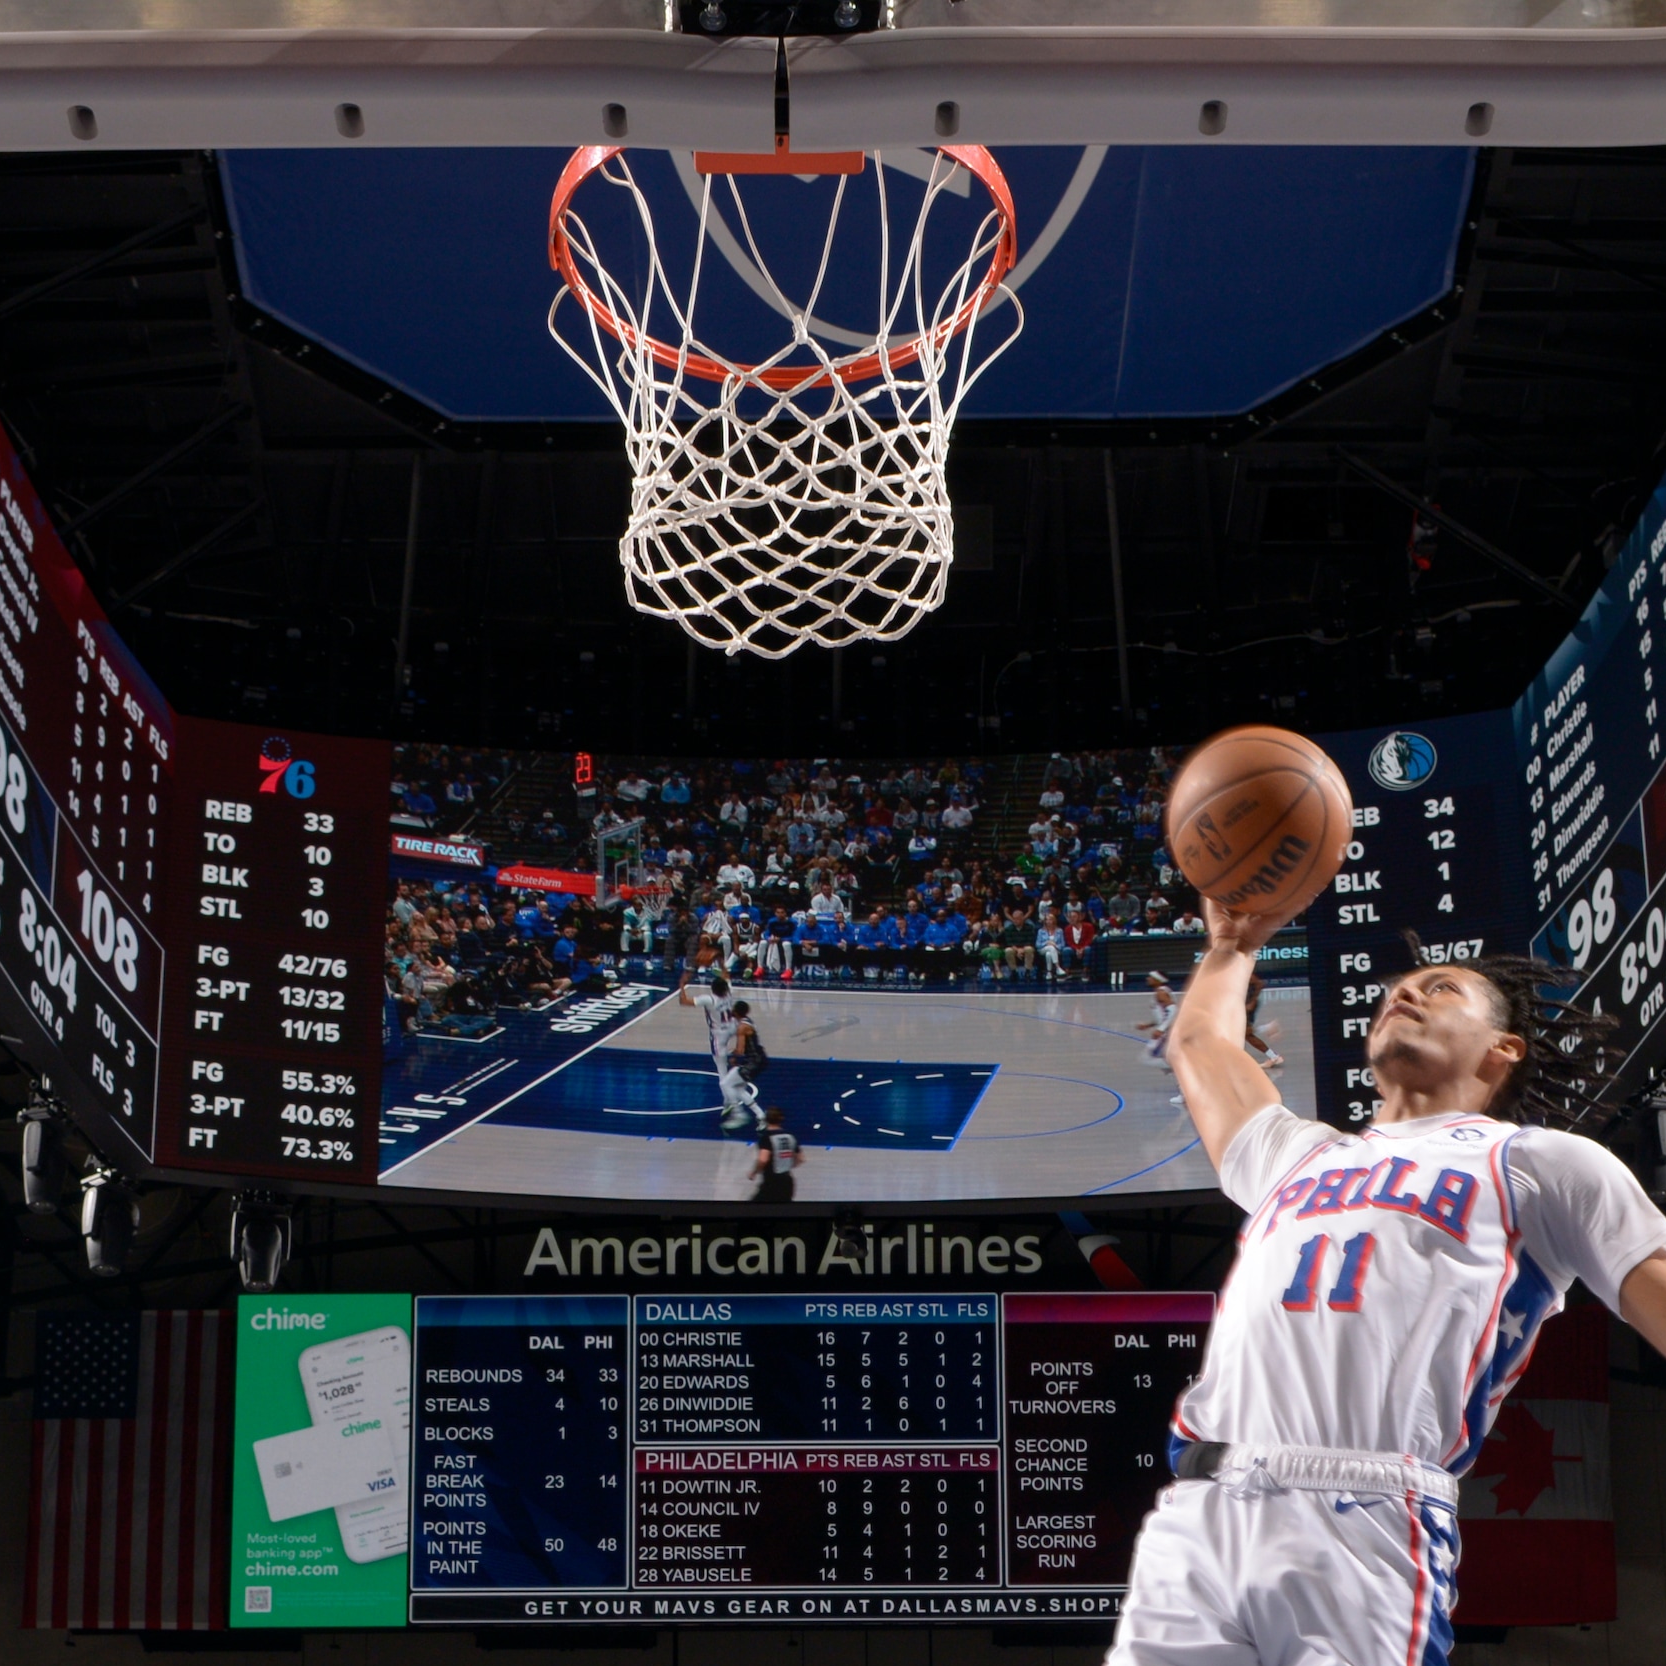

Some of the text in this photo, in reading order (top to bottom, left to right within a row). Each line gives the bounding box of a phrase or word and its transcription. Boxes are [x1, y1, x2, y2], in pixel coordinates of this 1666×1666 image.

[259, 759, 315, 799] 76
[206, 800, 333, 833] REB 33
[204, 832, 331, 865] TO 10
[203, 864, 323, 896] BLK 3
[200, 896, 329, 928] STL 10
[1568, 868, 1616, 970] 98
[77, 869, 138, 992] 108
[19, 888, 77, 1013] 8:04
[198, 945, 347, 978] FG 42/76
[196, 978, 344, 1010] 3-PT 13/32
[195, 1010, 340, 1042] FT 11/15
[191, 1061, 355, 1095] FG 55.3%
[190, 1094, 354, 1128] 3-PT 40.6%
[188, 1128, 353, 1161] FT 73.3%
[1262, 1157, 1480, 1244] PHILA
[524, 1224, 1042, 1275] American Airlines
[1282, 1232, 1377, 1312] 11
[646, 1303, 988, 1320] DALLAS PTS REB AST STL FLS
[251, 1308, 327, 1330] chime
[529, 1336, 612, 1349] DAL PHI
[663, 1332, 741, 1346] CHRISTIE
[663, 1354, 754, 1367] MARSHALL
[426, 1369, 618, 1383] REBOUNDS 34 33
[1032, 1363, 1092, 1375] POINTS
[663, 1375, 749, 1389] EDWARDS
[1046, 1382, 1078, 1394] OFF
[425, 1397, 618, 1412] STEALS 10
[663, 1397, 753, 1411] DINWIDDIE
[1010, 1400, 1115, 1413] TURNOVERS
[342, 1419, 381, 1438] chime
[663, 1419, 760, 1432] THOMPSON
[425, 1427, 493, 1440] BLOCKS
[1015, 1439, 1087, 1452] SECOND
[435, 1455, 477, 1468] FAST
[646, 1452, 798, 1470] PHILADELPHIA
[1016, 1459, 1087, 1471] CHANCE
[366, 1477, 396, 1493] VISA
[426, 1474, 616, 1488] BREAK 23 14
[663, 1480, 761, 1494] DOWTIN JR.
[1021, 1478, 1083, 1490] POINTS
[424, 1493, 486, 1507] POINTS
[663, 1502, 760, 1515] COUNCIL IV
[424, 1522, 486, 1535] POINTS
[1017, 1516, 1095, 1529] LARGEST
[663, 1524, 720, 1538] OKEKE
[428, 1538, 617, 1554] IN THE 50 48
[1017, 1535, 1096, 1548] SCORING
[663, 1546, 746, 1560] BRISSETT
[430, 1560, 479, 1573] PAINT
[1039, 1555, 1075, 1567] RUN
[245, 1563, 339, 1577] chime.com
[662, 1568, 751, 1582] YABUSELE
[525, 1601, 568, 1614] GET
[580, 1601, 641, 1614] YOUR
[655, 1601, 714, 1614] MAVS
[728, 1600, 789, 1613] GEAR
[802, 1600, 831, 1613] ON
[844, 1600, 869, 1613] AT
